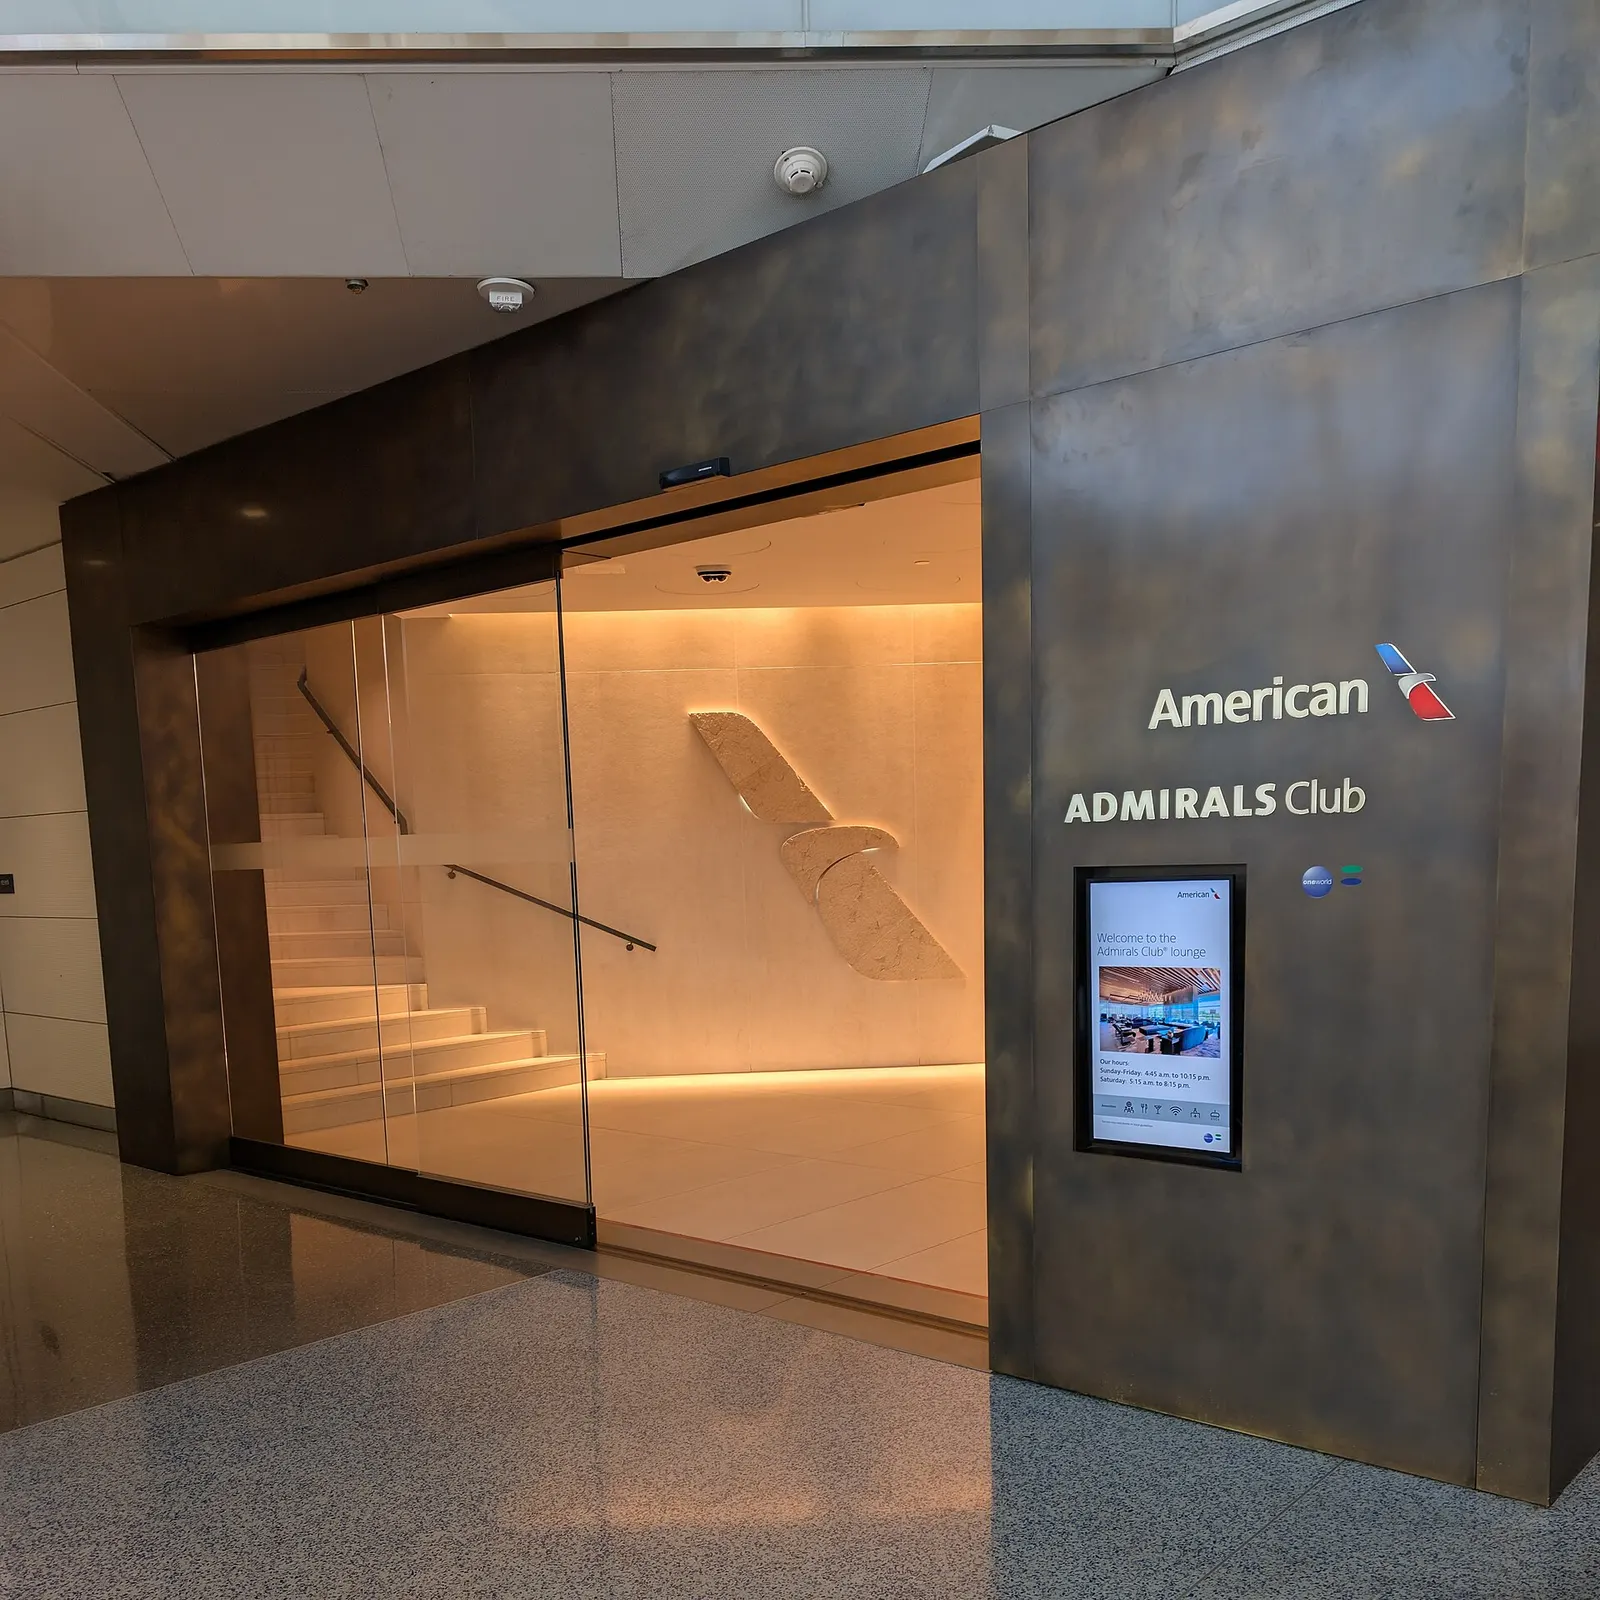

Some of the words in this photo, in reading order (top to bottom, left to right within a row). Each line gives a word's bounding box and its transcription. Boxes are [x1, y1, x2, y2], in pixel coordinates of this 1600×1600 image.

[1147, 675, 1370, 730] American
[1063, 782, 1277, 824] ADMIRALS
[1285, 777, 1366, 816] Club
[1302, 878, 1333, 886] oneworld
[1177, 890, 1210, 899] American
[1097, 933, 1144, 943] Welcome
[1146, 934, 1157, 943] to
[1159, 933, 1177, 943] the
[1096, 946, 1139, 957] Admirals
[1170, 947, 1206, 959] lounge
[1144, 1070, 1158, 1078] 4:45
[1180, 1072, 1197, 1080] 10:15
[1163, 1080, 1177, 1088] 8:15
